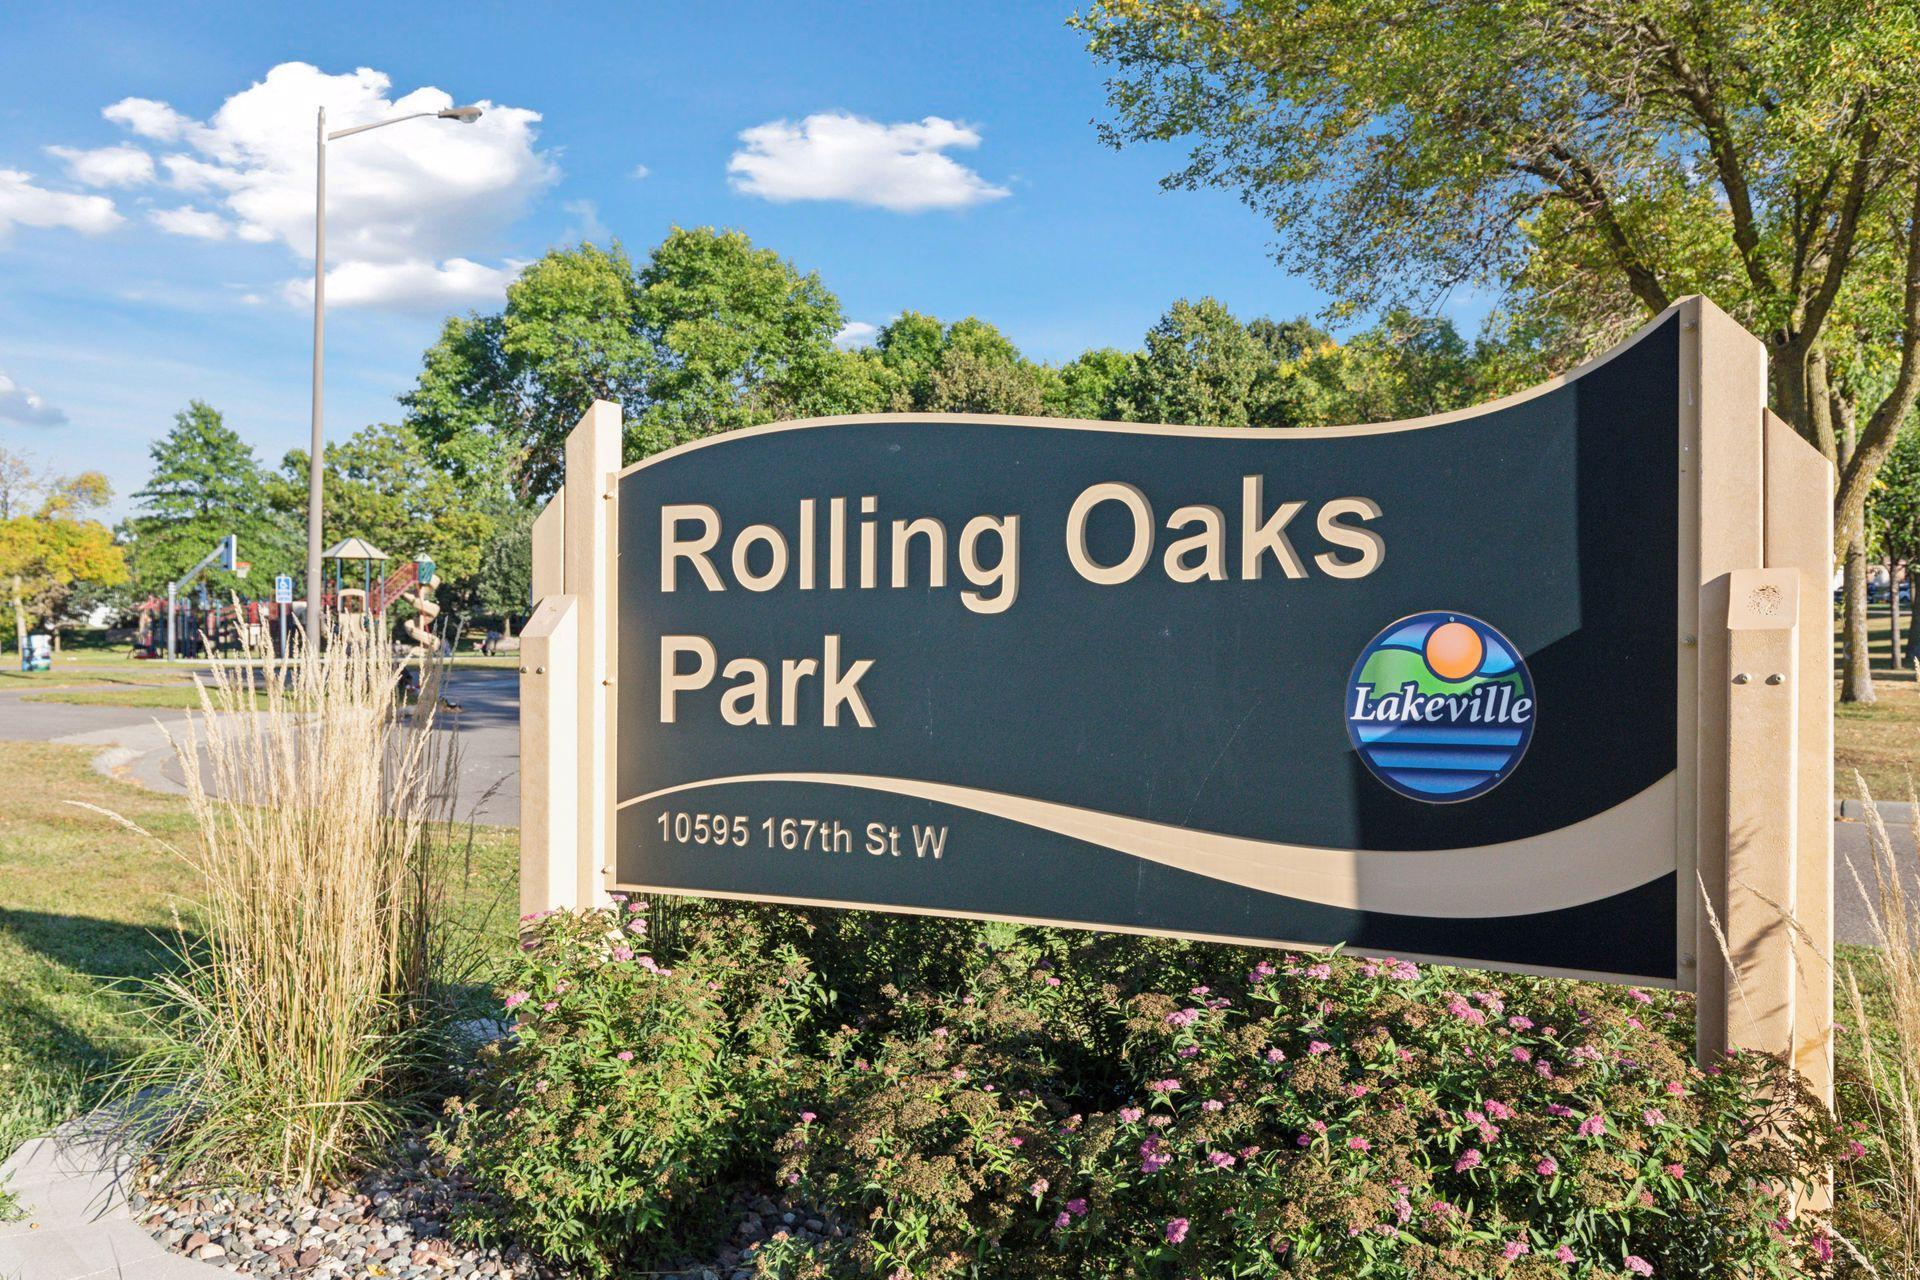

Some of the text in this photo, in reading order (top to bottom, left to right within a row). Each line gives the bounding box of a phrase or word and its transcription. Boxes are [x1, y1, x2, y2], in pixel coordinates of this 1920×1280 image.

[661, 475, 1385, 614] Rolling Oaks
[660, 634, 877, 728] Park
[1350, 685, 1533, 724] Lakeville
[657, 811, 948, 860] 10595 167th St W
